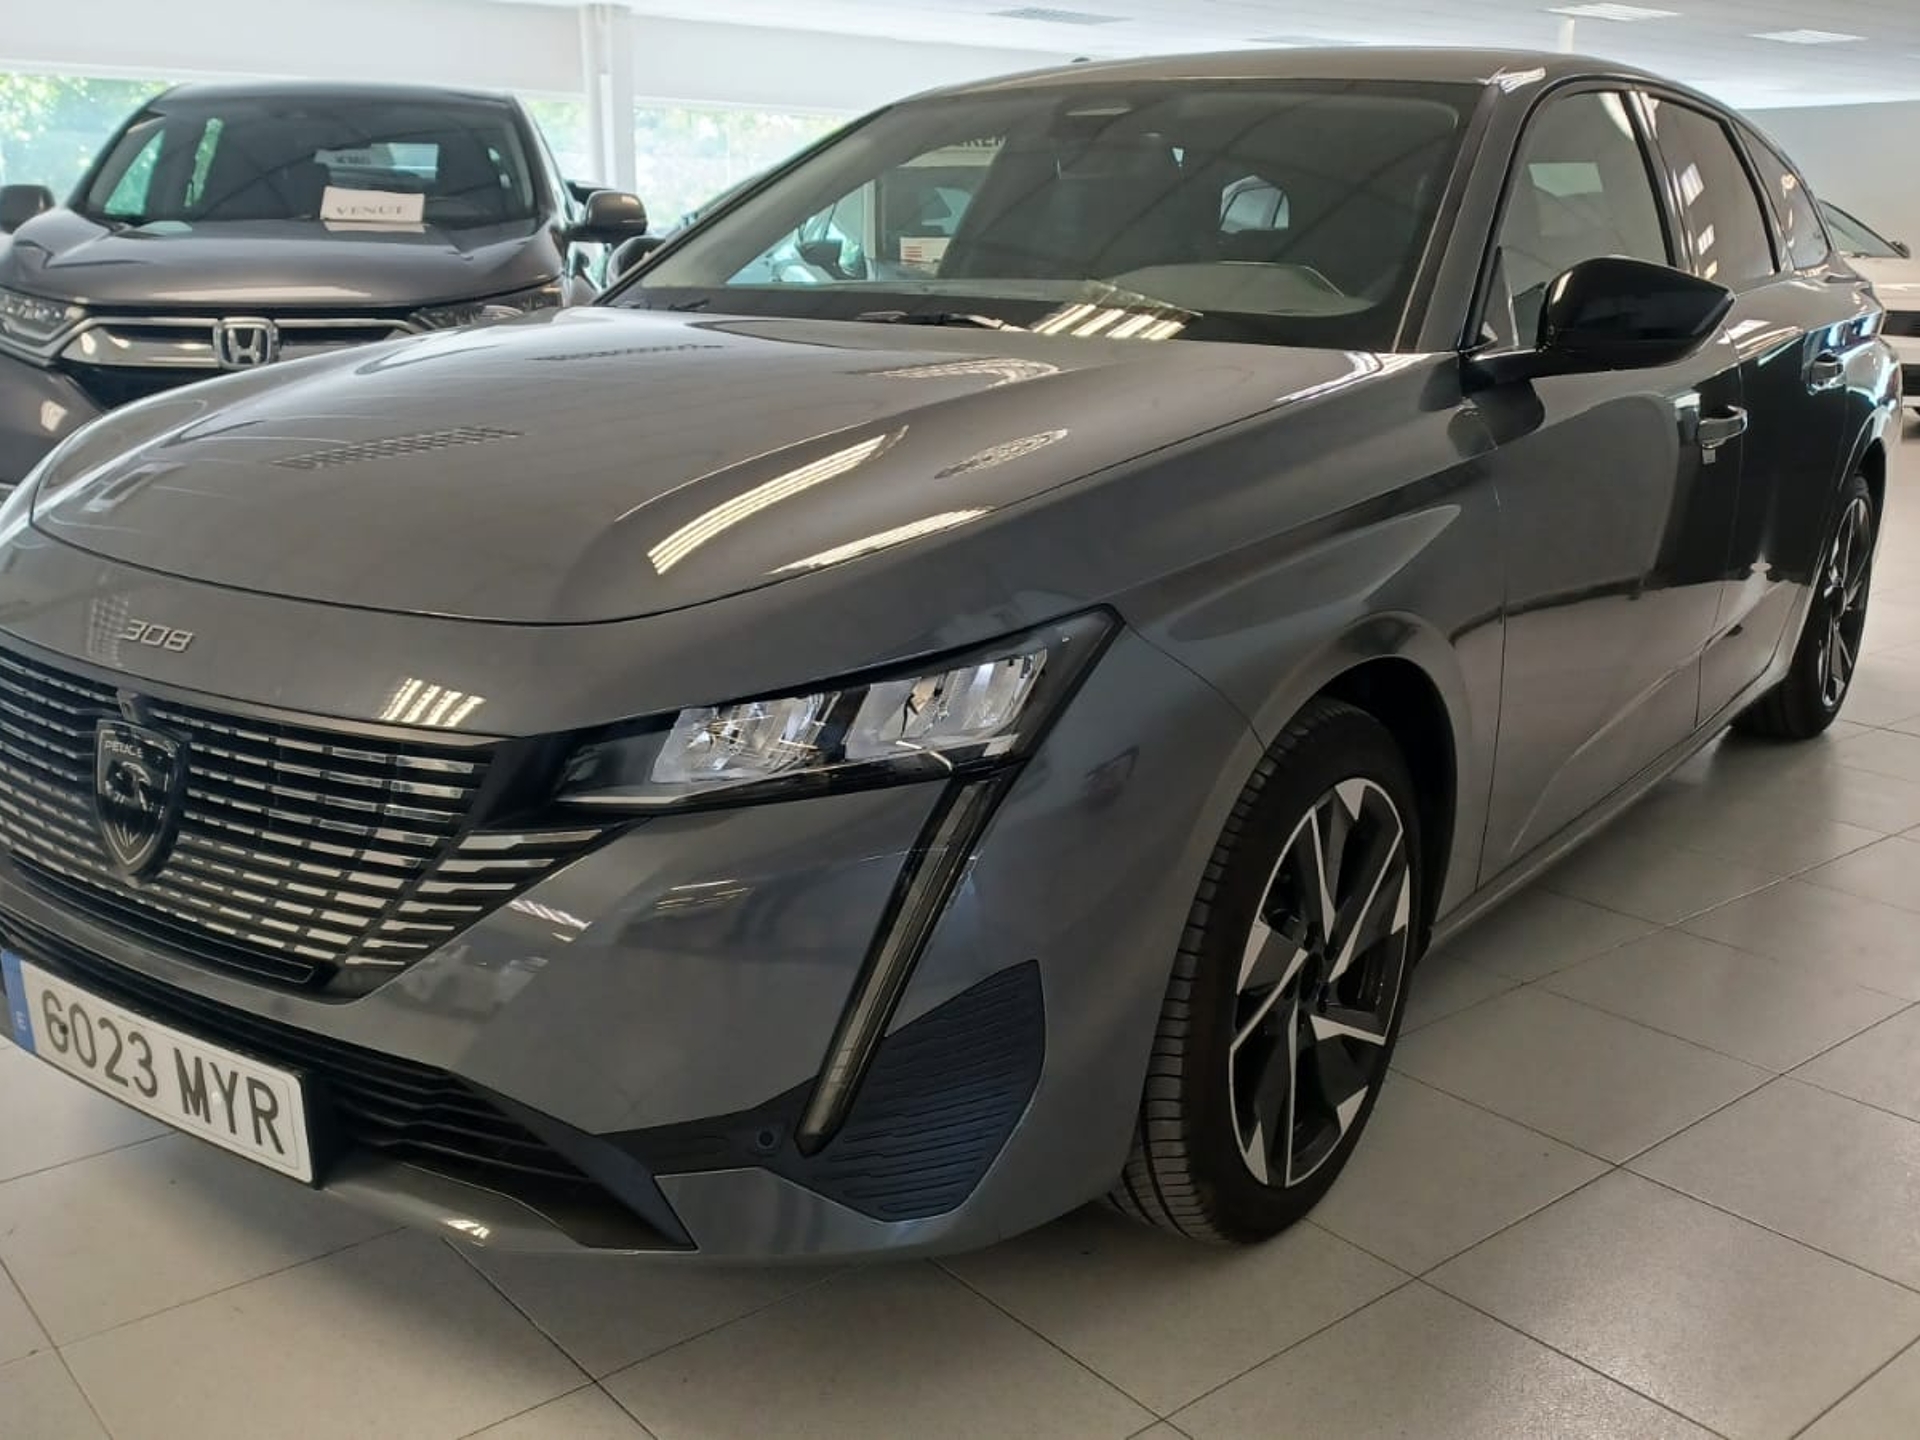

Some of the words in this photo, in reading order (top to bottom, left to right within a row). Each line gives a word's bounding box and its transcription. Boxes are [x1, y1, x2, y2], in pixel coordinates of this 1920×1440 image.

[119, 619, 193, 652] 308
[42, 989, 158, 1099] 6023
[173, 1047, 285, 1156] MYR
